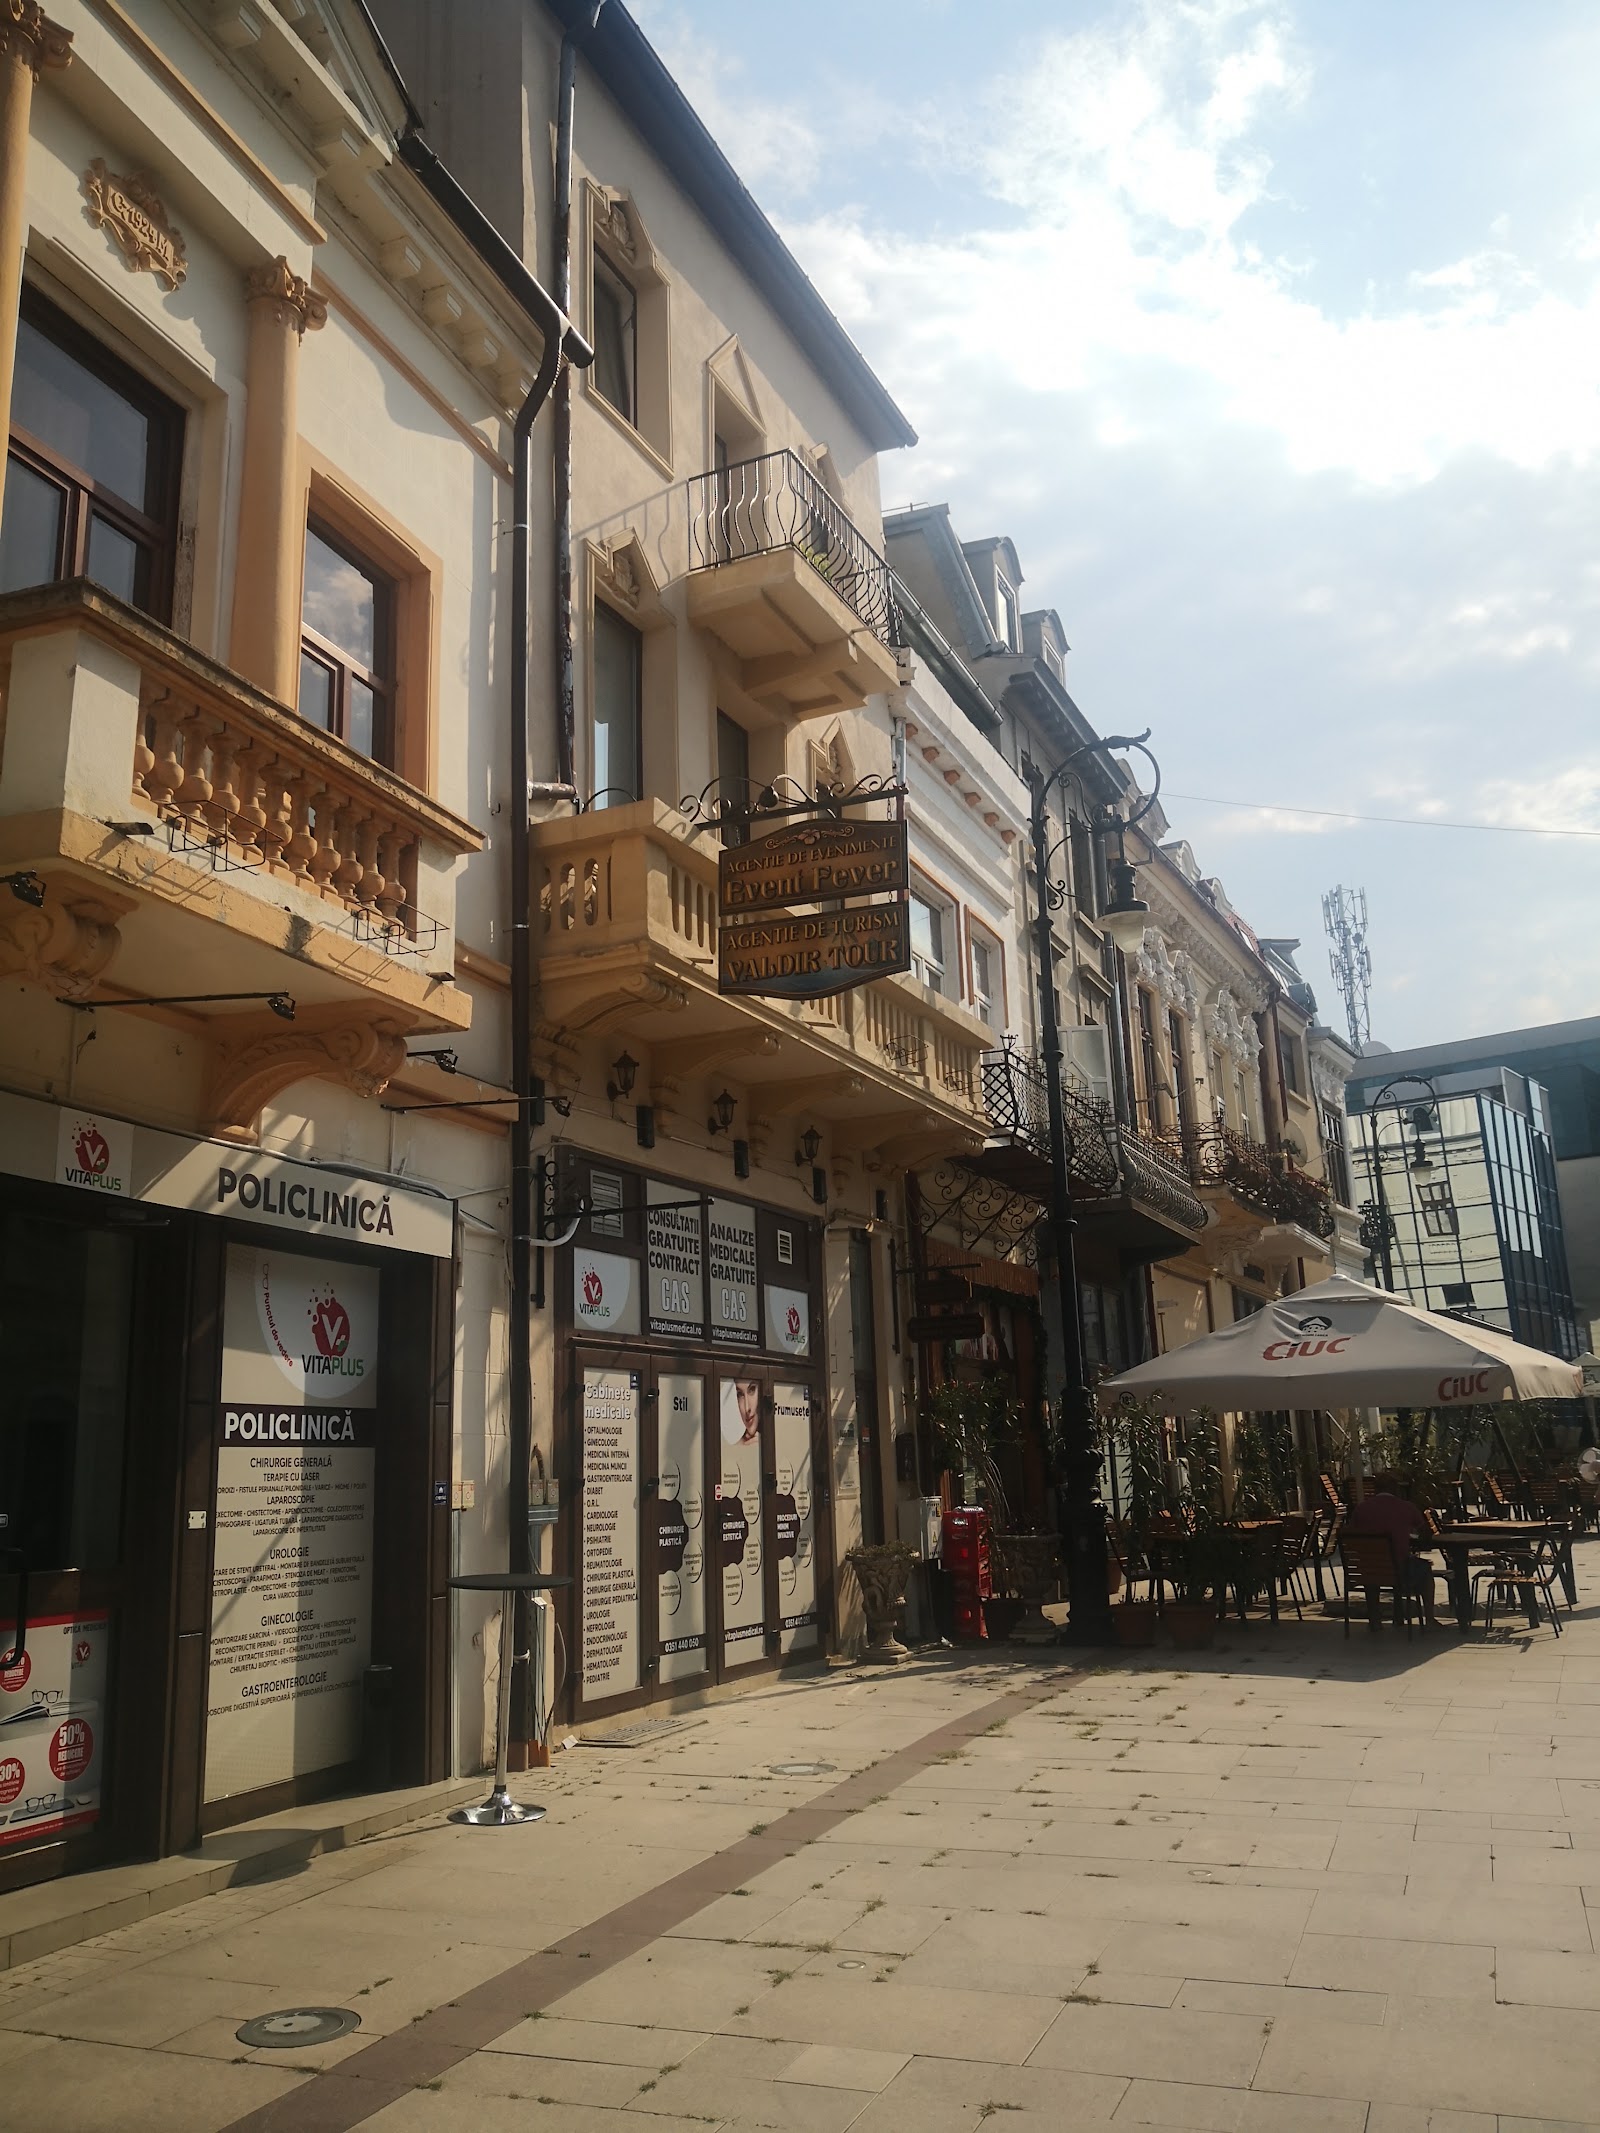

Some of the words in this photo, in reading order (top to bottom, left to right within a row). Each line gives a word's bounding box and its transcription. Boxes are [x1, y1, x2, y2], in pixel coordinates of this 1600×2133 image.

[728, 855, 784, 874] AGENTIE
[788, 850, 807, 865] DE
[810, 836, 897, 860] EVENIMENTE
[726, 870, 804, 905] Event
[812, 860, 898, 892] Fever
[727, 925, 799, 950] AGENTIE
[804, 921, 826, 939] DE
[832, 911, 898, 936] TURISM
[727, 950, 821, 983] VALDIR
[828, 939, 898, 969] TOUR
[65, 1167, 122, 1191] VITAPLUS
[218, 1167, 394, 1235] POLICLINICĂ
[710, 1223, 754, 1247] ANALIZE
[649, 1230, 700, 1255] GRATUITE
[711, 1243, 755, 1266] MEDICALE
[649, 1251, 700, 1275] CONTRACT
[711, 1263, 756, 1285] GRATUITE
[661, 1277, 690, 1314] CAS
[579, 1303, 610, 1317] VITAPLUS
[721, 1288, 747, 1322] CAS
[650, 1320, 702, 1335] vitaplusmedical.ro
[712, 1327, 757, 1342] vitaplusmedical.ro
[302, 1354, 364, 1377] VITAPLUS
[584, 1381, 631, 1400] Cabinete
[584, 1402, 631, 1419] medicale
[673, 1396, 688, 1412] Stil
[224, 1410, 355, 1440] POLICLINICĂ
[587, 1427, 622, 1435] OFTALMOLOGIE
[250, 1458, 292, 1468] CHIRURGIE
[294, 1454, 332, 1467] GENERALĂ
[263, 1473, 289, 1482] TERAPIE
[290, 1473, 299, 1481] CU
[301, 1473, 320, 1481] LASER
[587, 1487, 603, 1495] DIABET
[266, 1495, 315, 1505] LAPAROSCOPIE
[587, 1511, 618, 1520] CARDIOLOGIE
[253, 1527, 288, 1536] LAPAROSCOPIE
[289, 1526, 296, 1534] DE
[587, 1523, 616, 1532] NEUROLOGIE
[659, 1524, 685, 1535] CHIRURGIE
[723, 1520, 745, 1530] CHIRURGIE
[586, 1535, 611, 1544] PSIHIATRIE
[659, 1536, 682, 1547] PLASTICĂ
[723, 1530, 742, 1541] ESTETICĂ
[269, 1547, 310, 1559] UROLOGIE
[586, 1547, 612, 1557] ORTOPEDIE
[237, 1566, 252, 1574] STENT
[586, 1559, 622, 1570] REUMATOLOGIE
[586, 1572, 611, 1582] CHIRURGIE
[586, 1584, 611, 1595] CHIRURGIE
[586, 1597, 611, 1607] CHIRURGIE
[261, 1609, 314, 1626] GINECOLOGIE
[586, 1610, 610, 1620] UROLOGIE
[586, 1621, 615, 1633] NEFROLOGIE
[725, 1626, 763, 1641] vitaplusmedical.ro
[257, 1640, 277, 1650] PERINEU
[586, 1631, 627, 1645] ENDOCRINOLOGIE
[586, 1645, 622, 1659] DERMATOLOGIE
[230, 1663, 257, 1674] CHIURETAJ
[586, 1658, 620, 1671] HEMATOLOGIE
[242, 1671, 328, 1698] GASTROENTEROLOGIE
[586, 1672, 610, 1684] PEDIATRIE
[59, 1723, 85, 1746] 50%
